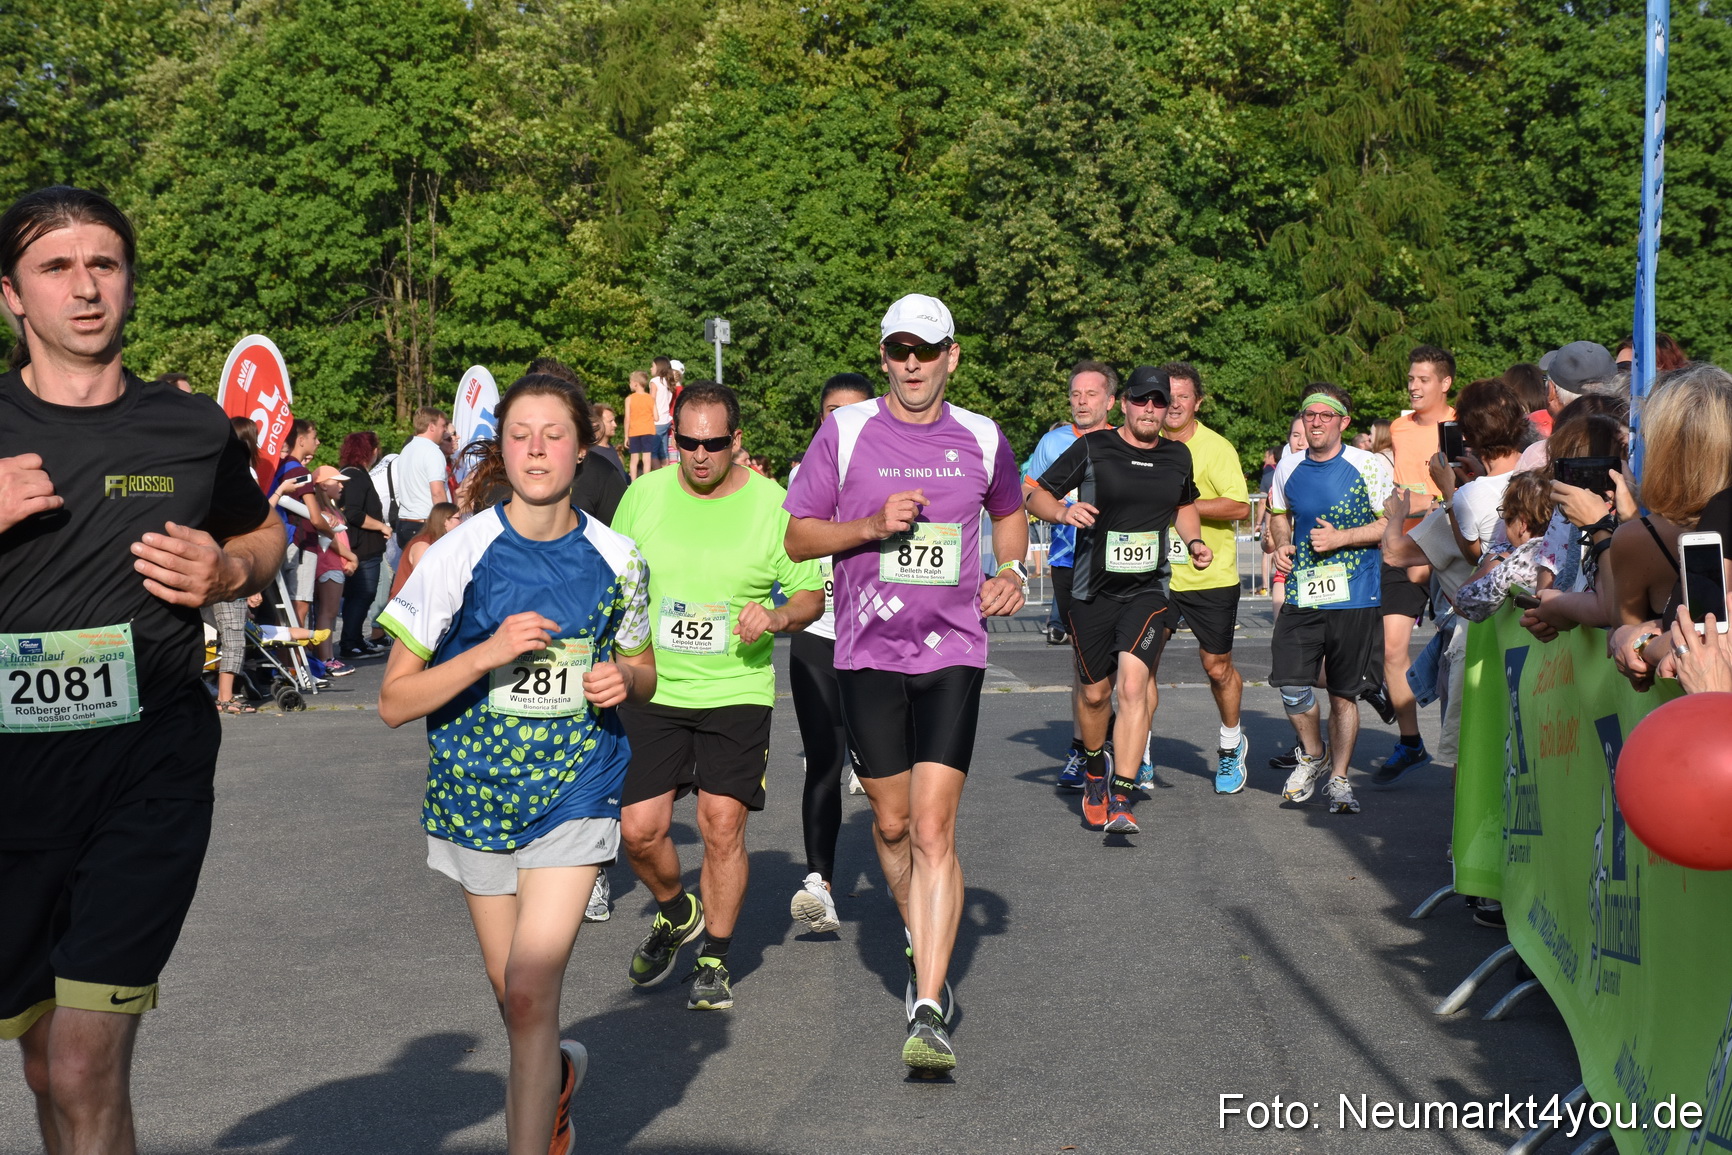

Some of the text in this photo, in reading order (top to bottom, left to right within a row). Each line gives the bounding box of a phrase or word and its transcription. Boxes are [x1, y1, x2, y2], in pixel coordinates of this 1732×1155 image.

[236, 359, 252, 389] AVIA
[465, 377, 478, 404] AVIA
[878, 467, 966, 478] WIR SIND LILA.
[128, 475, 175, 493] ROSSBO
[897, 544, 944, 568] 878
[1113, 546, 1152, 562] 1991
[1307, 579, 1336, 596] 210
[670, 619, 714, 641] 452
[672, 638, 694, 646] Leipold
[10, 650, 66, 663] firmenlauf
[99, 651, 125, 662] 2019
[570, 658, 587, 667] 2019
[8, 662, 113, 705] 2081
[511, 666, 568, 696] 281
[509, 694, 572, 704] Wuest Christina
[15, 699, 118, 717] Roßberger Thomas
[37, 713, 72, 723] ROSSBO
[72, 710, 96, 721] GmbH
